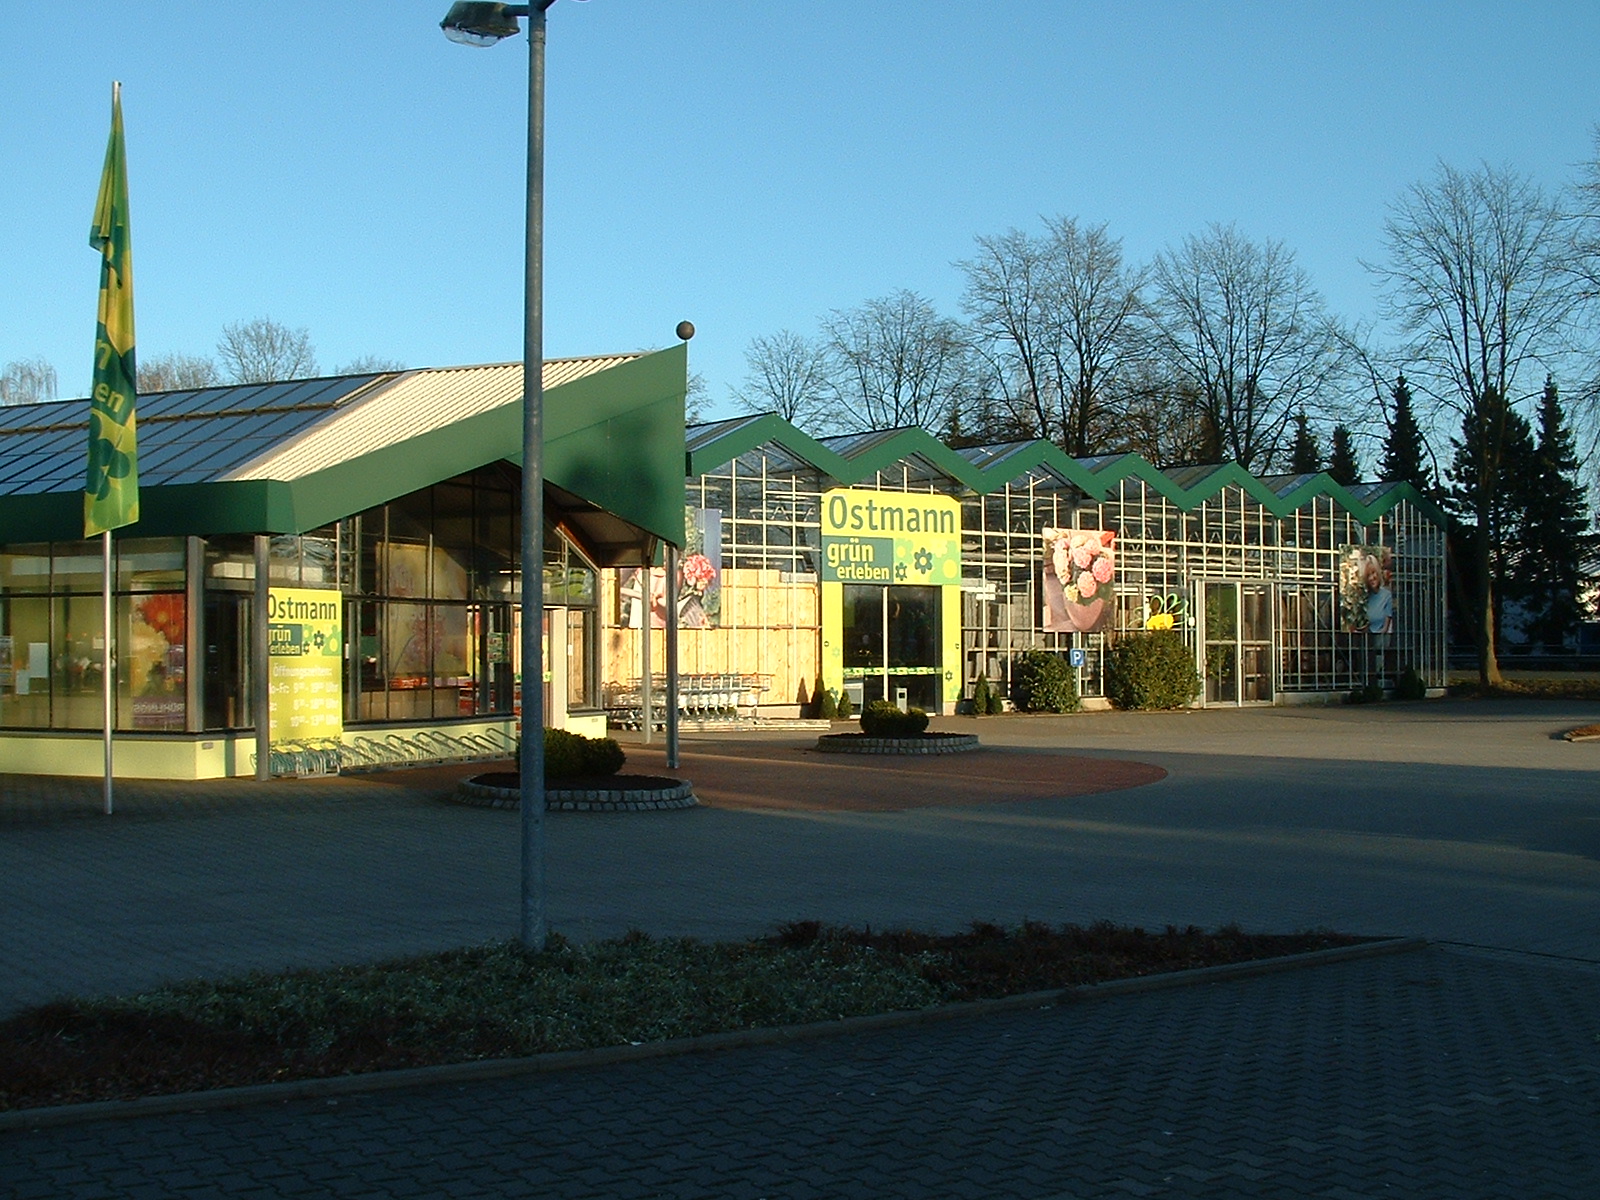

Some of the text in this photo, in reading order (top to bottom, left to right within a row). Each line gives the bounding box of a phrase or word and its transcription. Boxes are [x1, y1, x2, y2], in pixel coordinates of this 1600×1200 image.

[829, 496, 954, 533] Ostmann
[827, 537, 874, 568] grün
[837, 562, 890, 579] erleben
[268, 593, 337, 620] Ostmann
[1073, 651, 1082, 663] P
